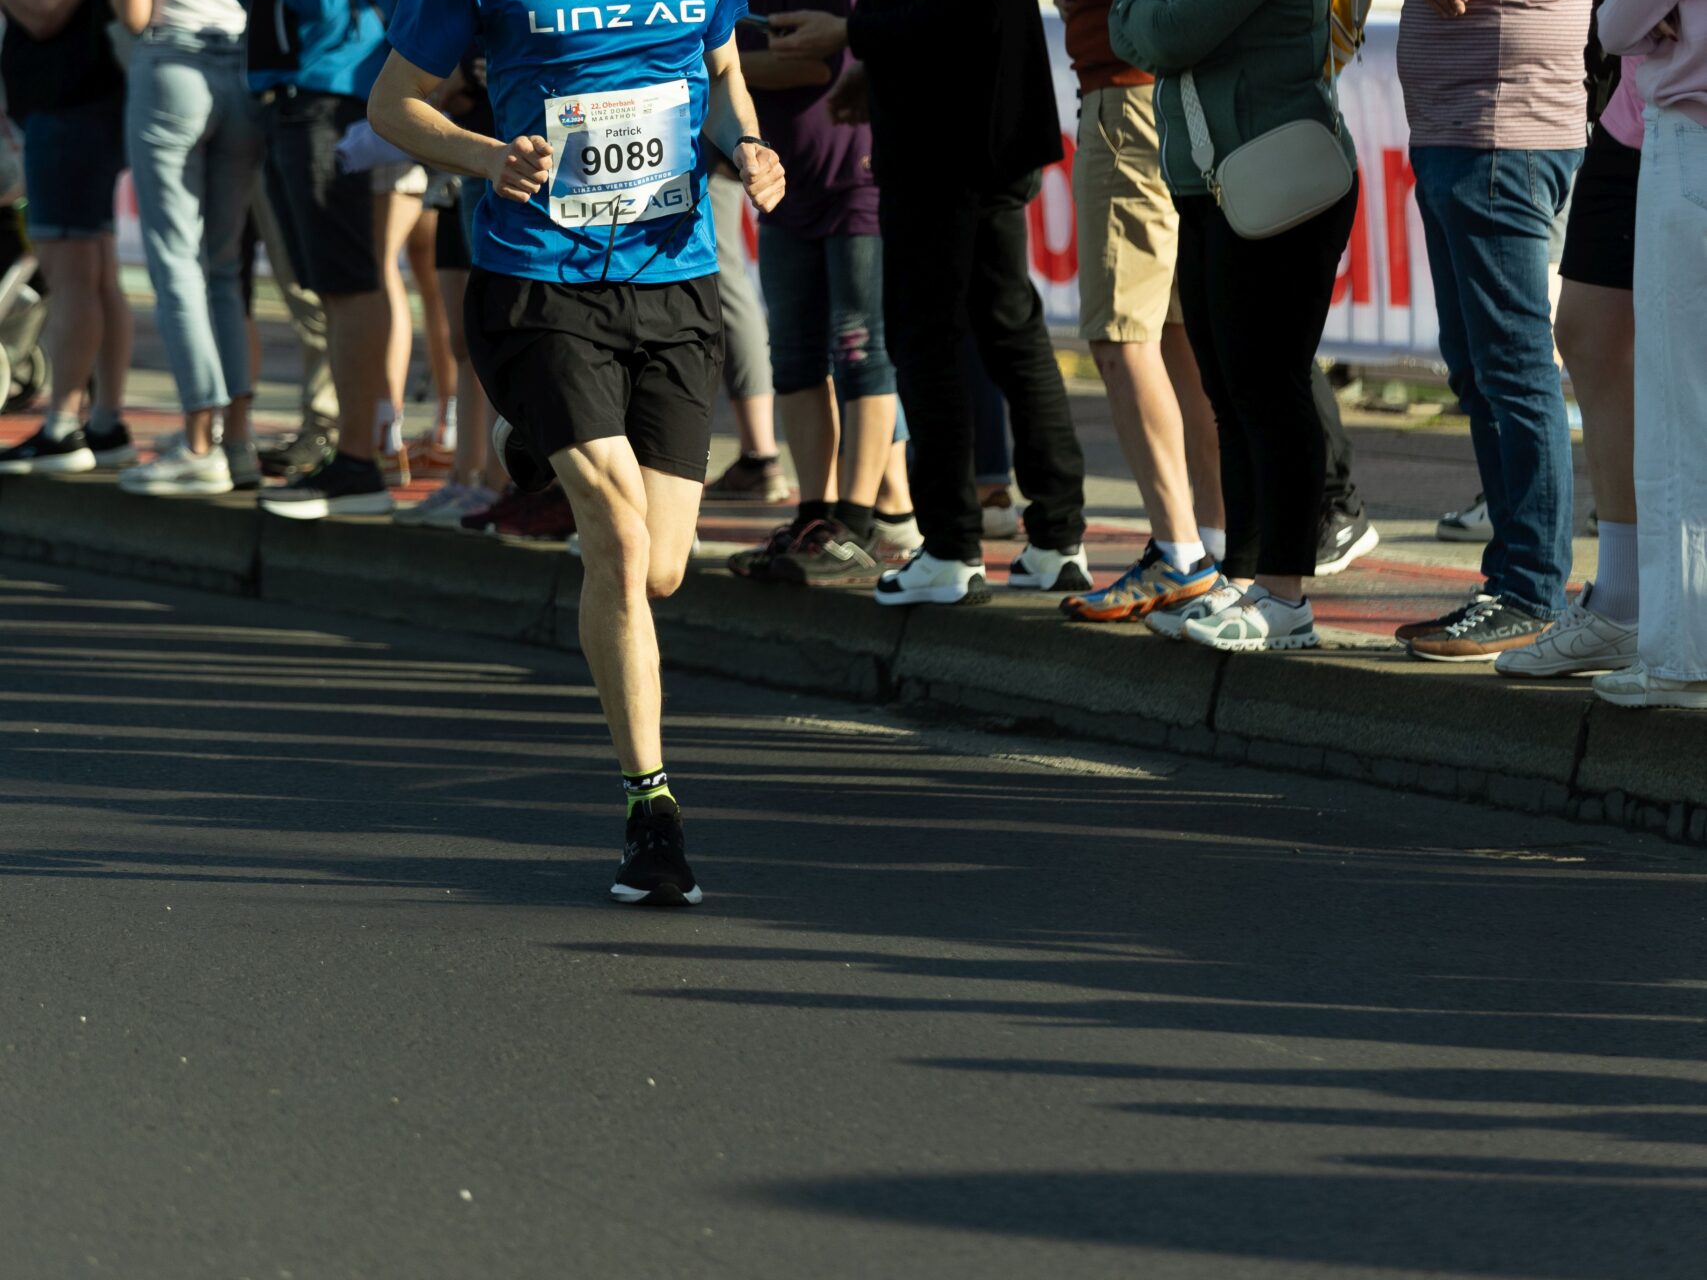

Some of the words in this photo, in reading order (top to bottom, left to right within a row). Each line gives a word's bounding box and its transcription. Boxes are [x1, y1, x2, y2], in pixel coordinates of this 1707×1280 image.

[528, 4, 633, 34] LINZ
[644, 0, 706, 26] AG
[591, 109, 607, 117] LINZ
[610, 106, 636, 114] DONAU
[602, 99, 636, 109] Oberbank
[591, 113, 636, 122] MARATHON
[605, 126, 642, 138] Patrick
[581, 137, 664, 176] 9089
[605, 171, 672, 190] VIERTELMARATHON
[560, 198, 637, 220] LINZ
[644, 188, 683, 213] AG
